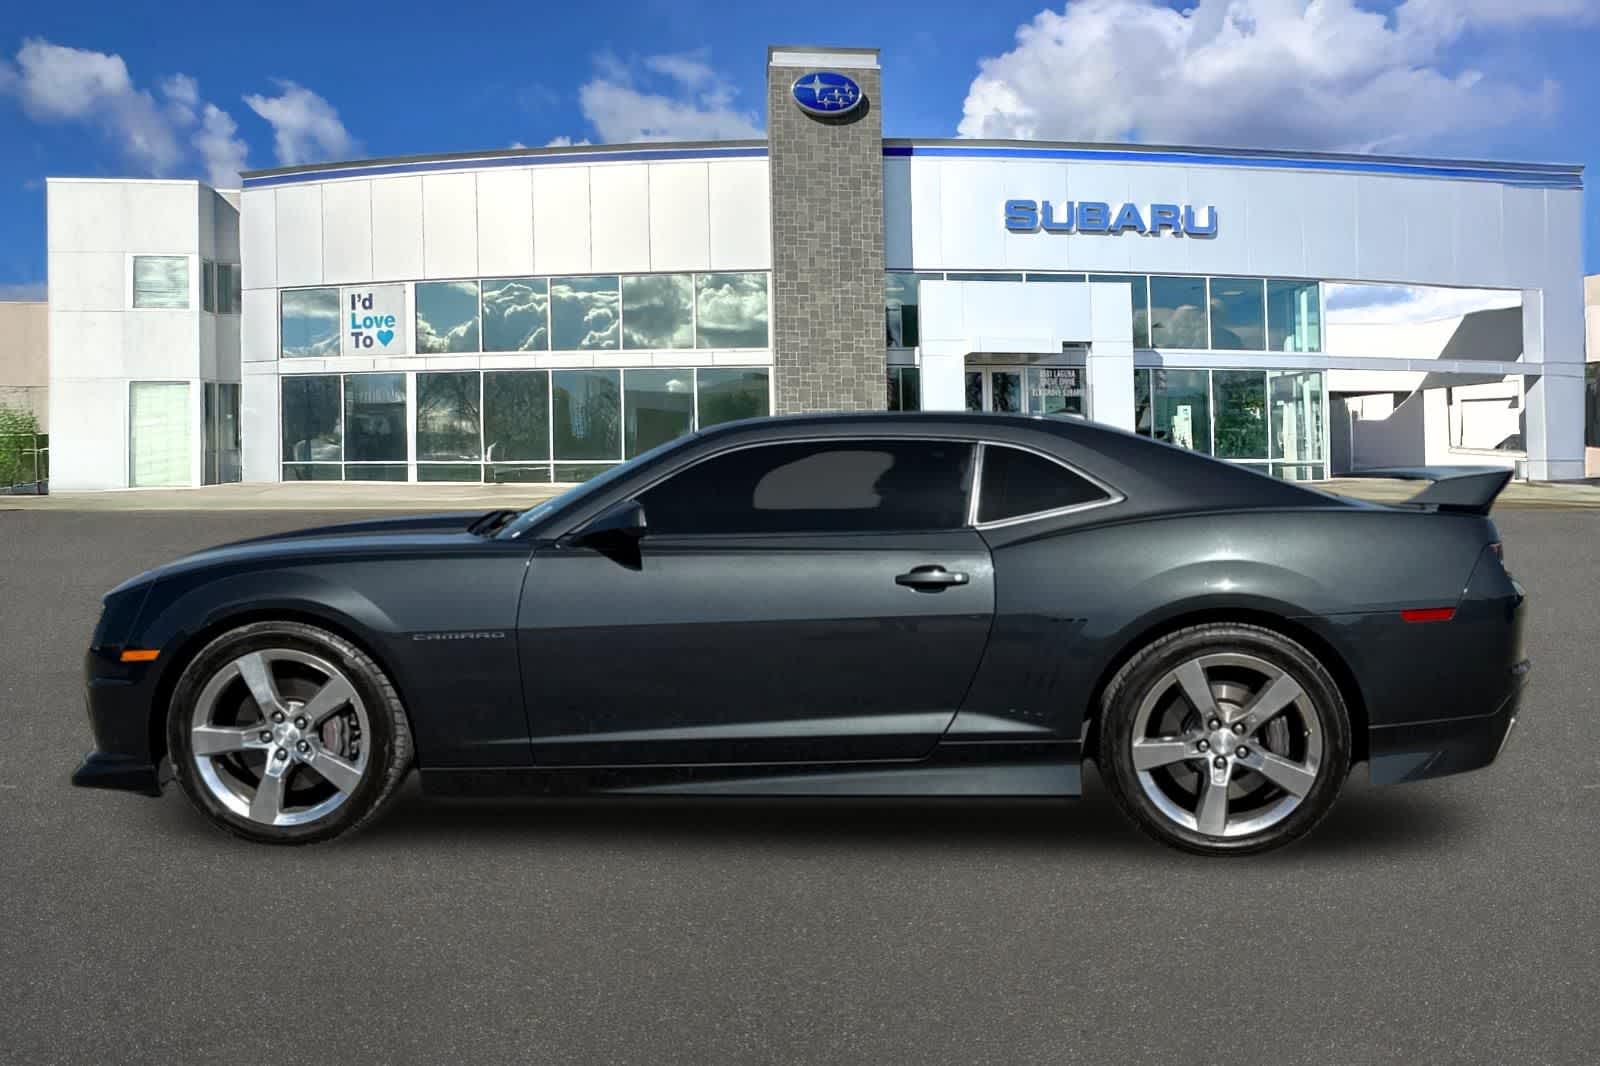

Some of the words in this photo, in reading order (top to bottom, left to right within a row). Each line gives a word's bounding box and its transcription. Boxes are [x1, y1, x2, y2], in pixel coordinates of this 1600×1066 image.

[1004, 199, 1218, 238] SUBARU
[351, 293, 373, 310] I'd
[351, 312, 396, 329] Love
[350, 332, 374, 348] To
[412, 631, 505, 641] CAMARO
